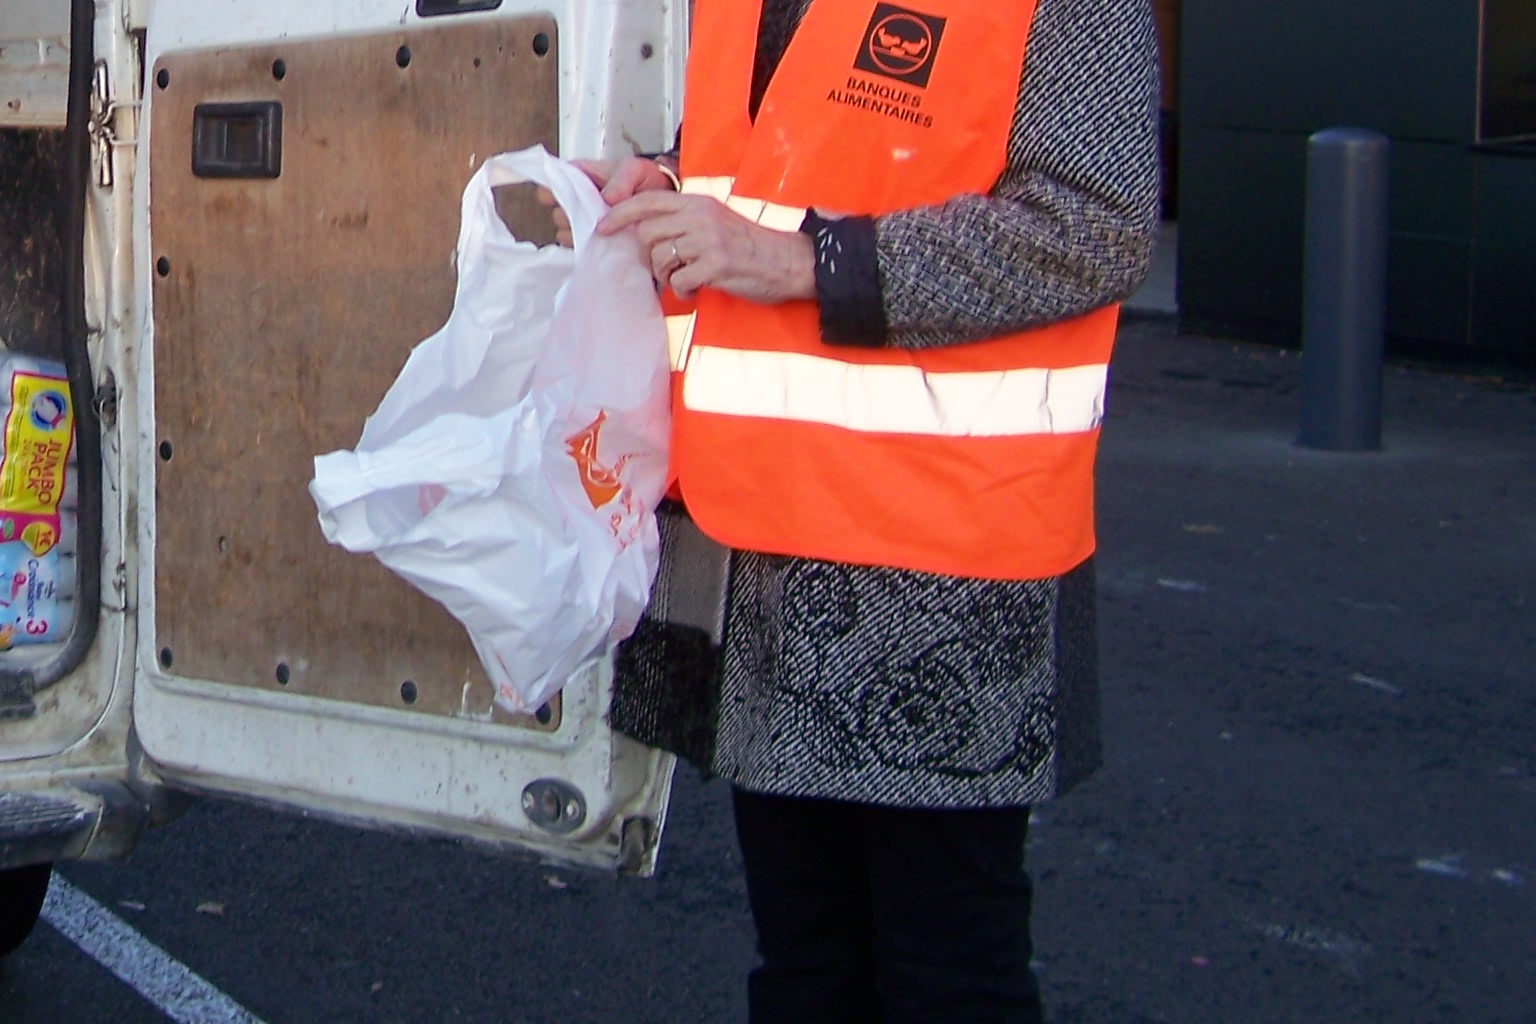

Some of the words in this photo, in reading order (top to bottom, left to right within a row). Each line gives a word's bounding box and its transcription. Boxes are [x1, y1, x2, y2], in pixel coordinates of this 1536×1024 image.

[827, 89, 933, 128] ALIMENTAIRES
[846, 76, 922, 108] BANQUES
[27, 441, 49, 491] PACK
[38, 437, 64, 505] JUMBO
[26, 619, 49, 636] 3
